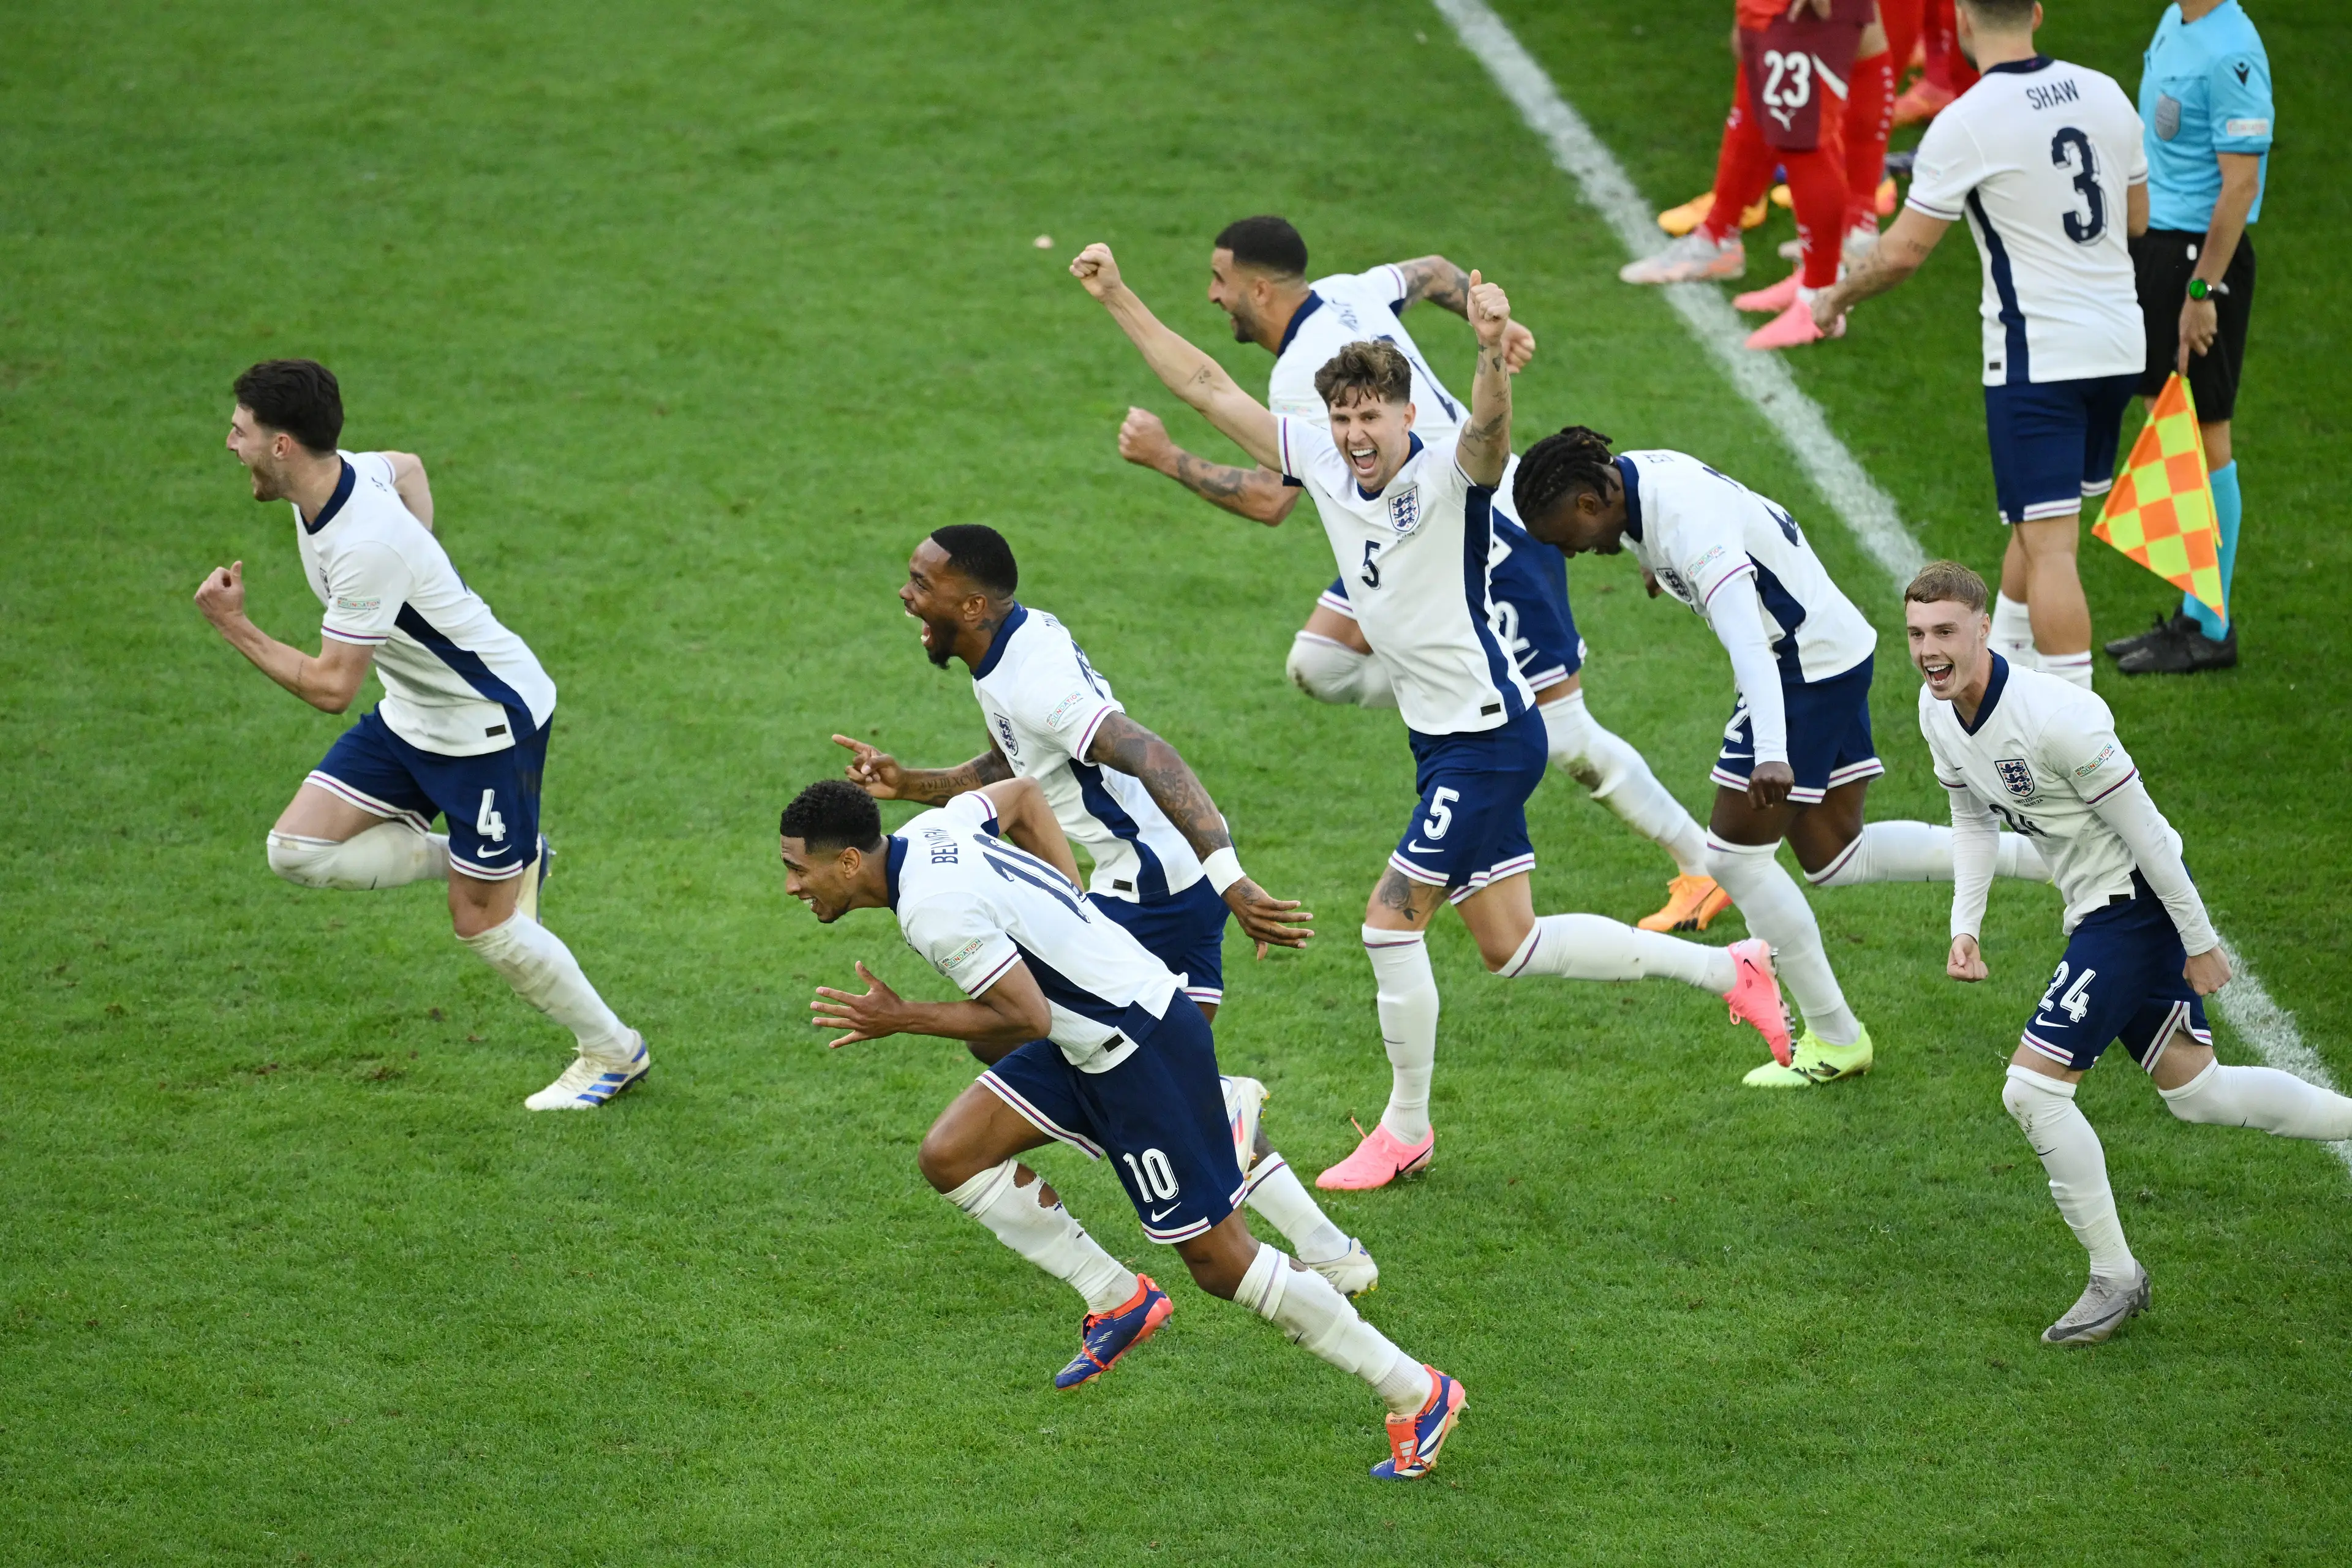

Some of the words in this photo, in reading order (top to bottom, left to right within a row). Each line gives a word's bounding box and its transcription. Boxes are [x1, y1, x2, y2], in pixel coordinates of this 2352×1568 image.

[1762, 49, 1811, 108] 23
[2026, 78, 2080, 110] SHAW
[2051, 127, 2108, 247] 3
[1361, 540, 1381, 590] 5
[2077, 744, 2113, 777] FOUNDATION
[477, 788, 506, 842] 4
[1423, 786, 1460, 840] 5
[944, 938, 981, 967] FOUNDATION
[2038, 960, 2096, 1023] 24
[1123, 1148, 1179, 1203] 10
